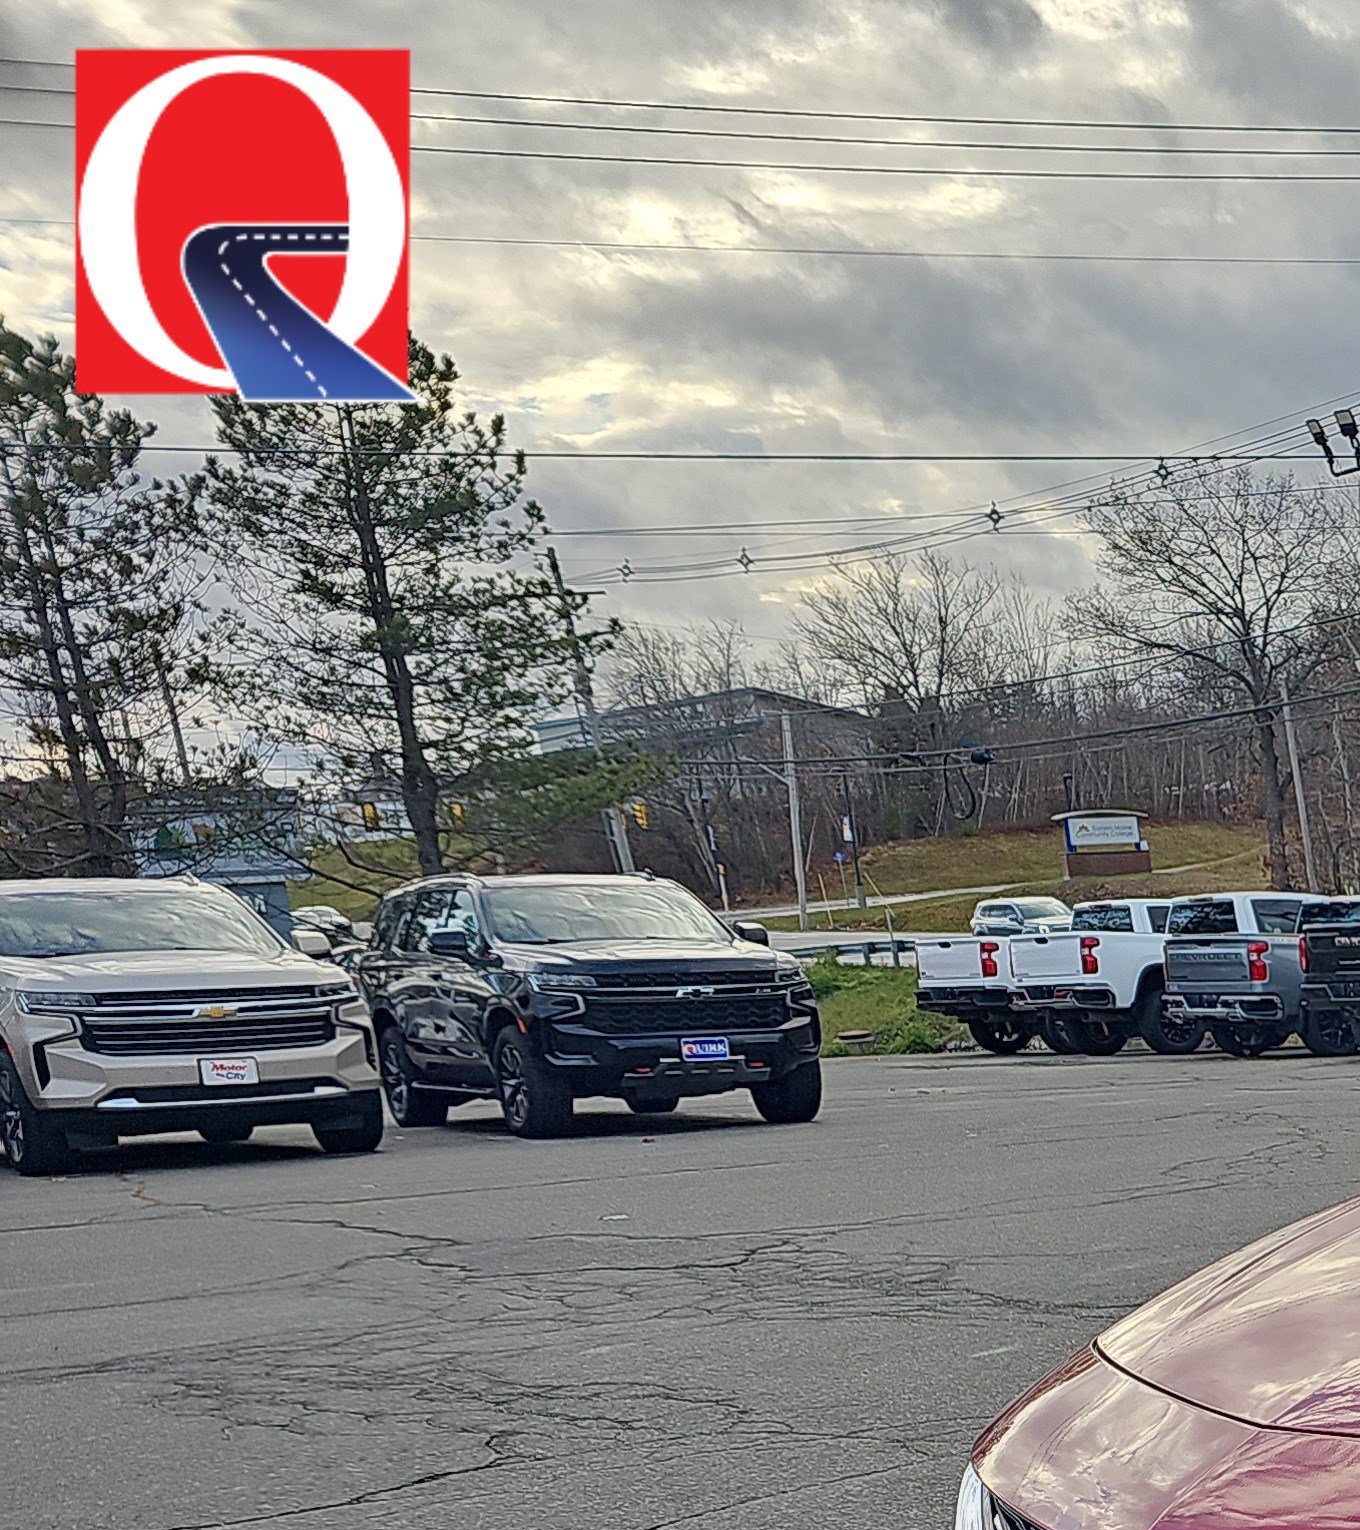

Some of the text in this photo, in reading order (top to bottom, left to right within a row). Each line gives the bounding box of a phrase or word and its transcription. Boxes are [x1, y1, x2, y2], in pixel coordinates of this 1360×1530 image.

[682, 1041, 727, 1055] QUIRK
[210, 1063, 248, 1072] Motor
[225, 1071, 247, 1081] City
